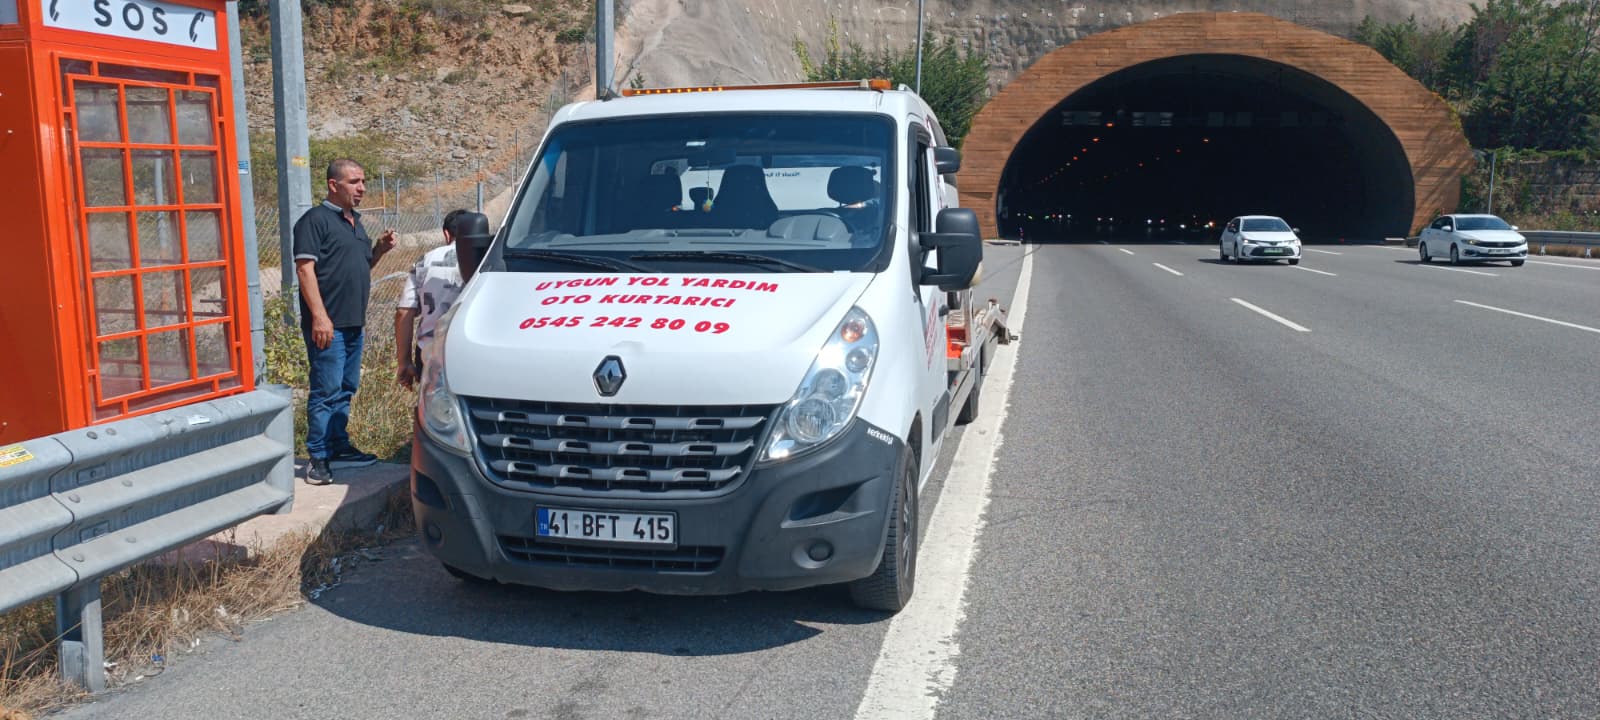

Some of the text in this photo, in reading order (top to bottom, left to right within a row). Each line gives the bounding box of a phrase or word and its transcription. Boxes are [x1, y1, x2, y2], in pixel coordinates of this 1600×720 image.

[93, 0, 168, 35] SOS
[535, 277, 779, 293] UYGUN YOL YARDIM
[541, 294, 736, 308] OTO KURTARICI
[519, 316, 730, 334] 0545 242 80 09
[549, 511, 670, 540] 41 BFT 415
